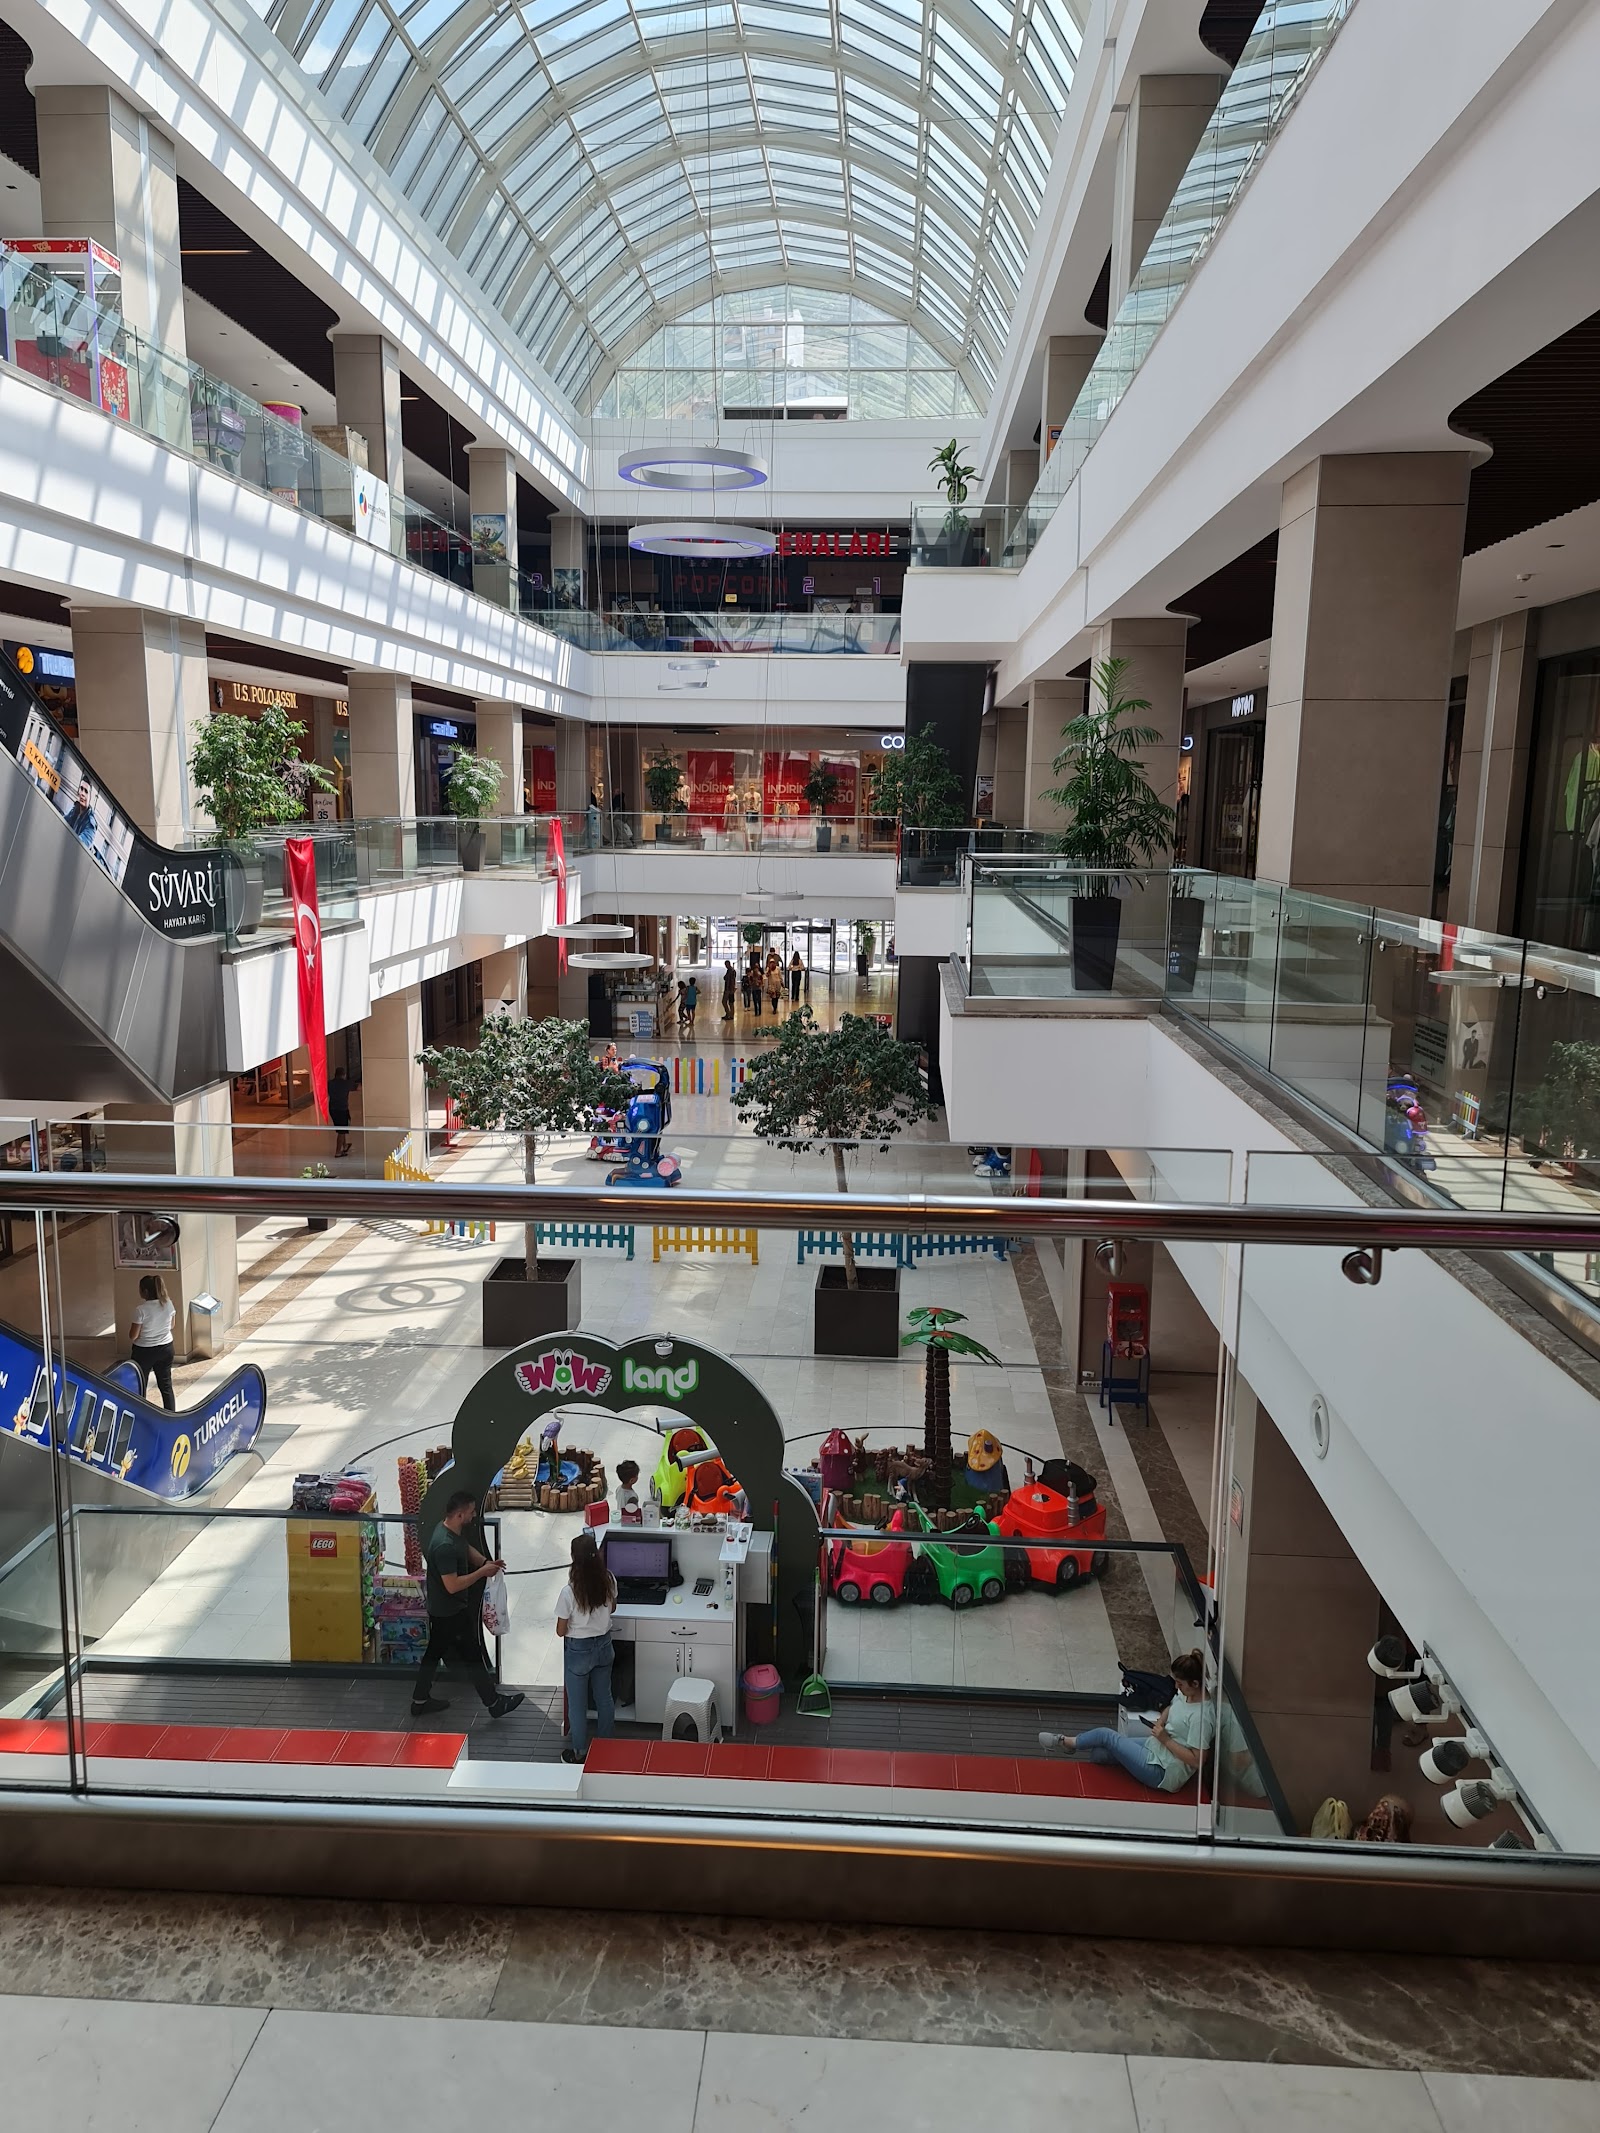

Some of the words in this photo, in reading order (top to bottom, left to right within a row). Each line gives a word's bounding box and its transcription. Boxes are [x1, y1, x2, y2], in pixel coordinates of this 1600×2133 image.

[770, 532, 890, 557] EMALARI
[802, 577, 815, 594] 2
[873, 577, 881, 594] 1
[251, 686, 274, 706] POLO
[880, 735, 905, 749] CO
[163, 916, 187, 929] HAYATA
[623, 1358, 698, 1400] land
[193, 1388, 249, 1451] TURKCELL
[312, 1538, 335, 1549] LEGO
